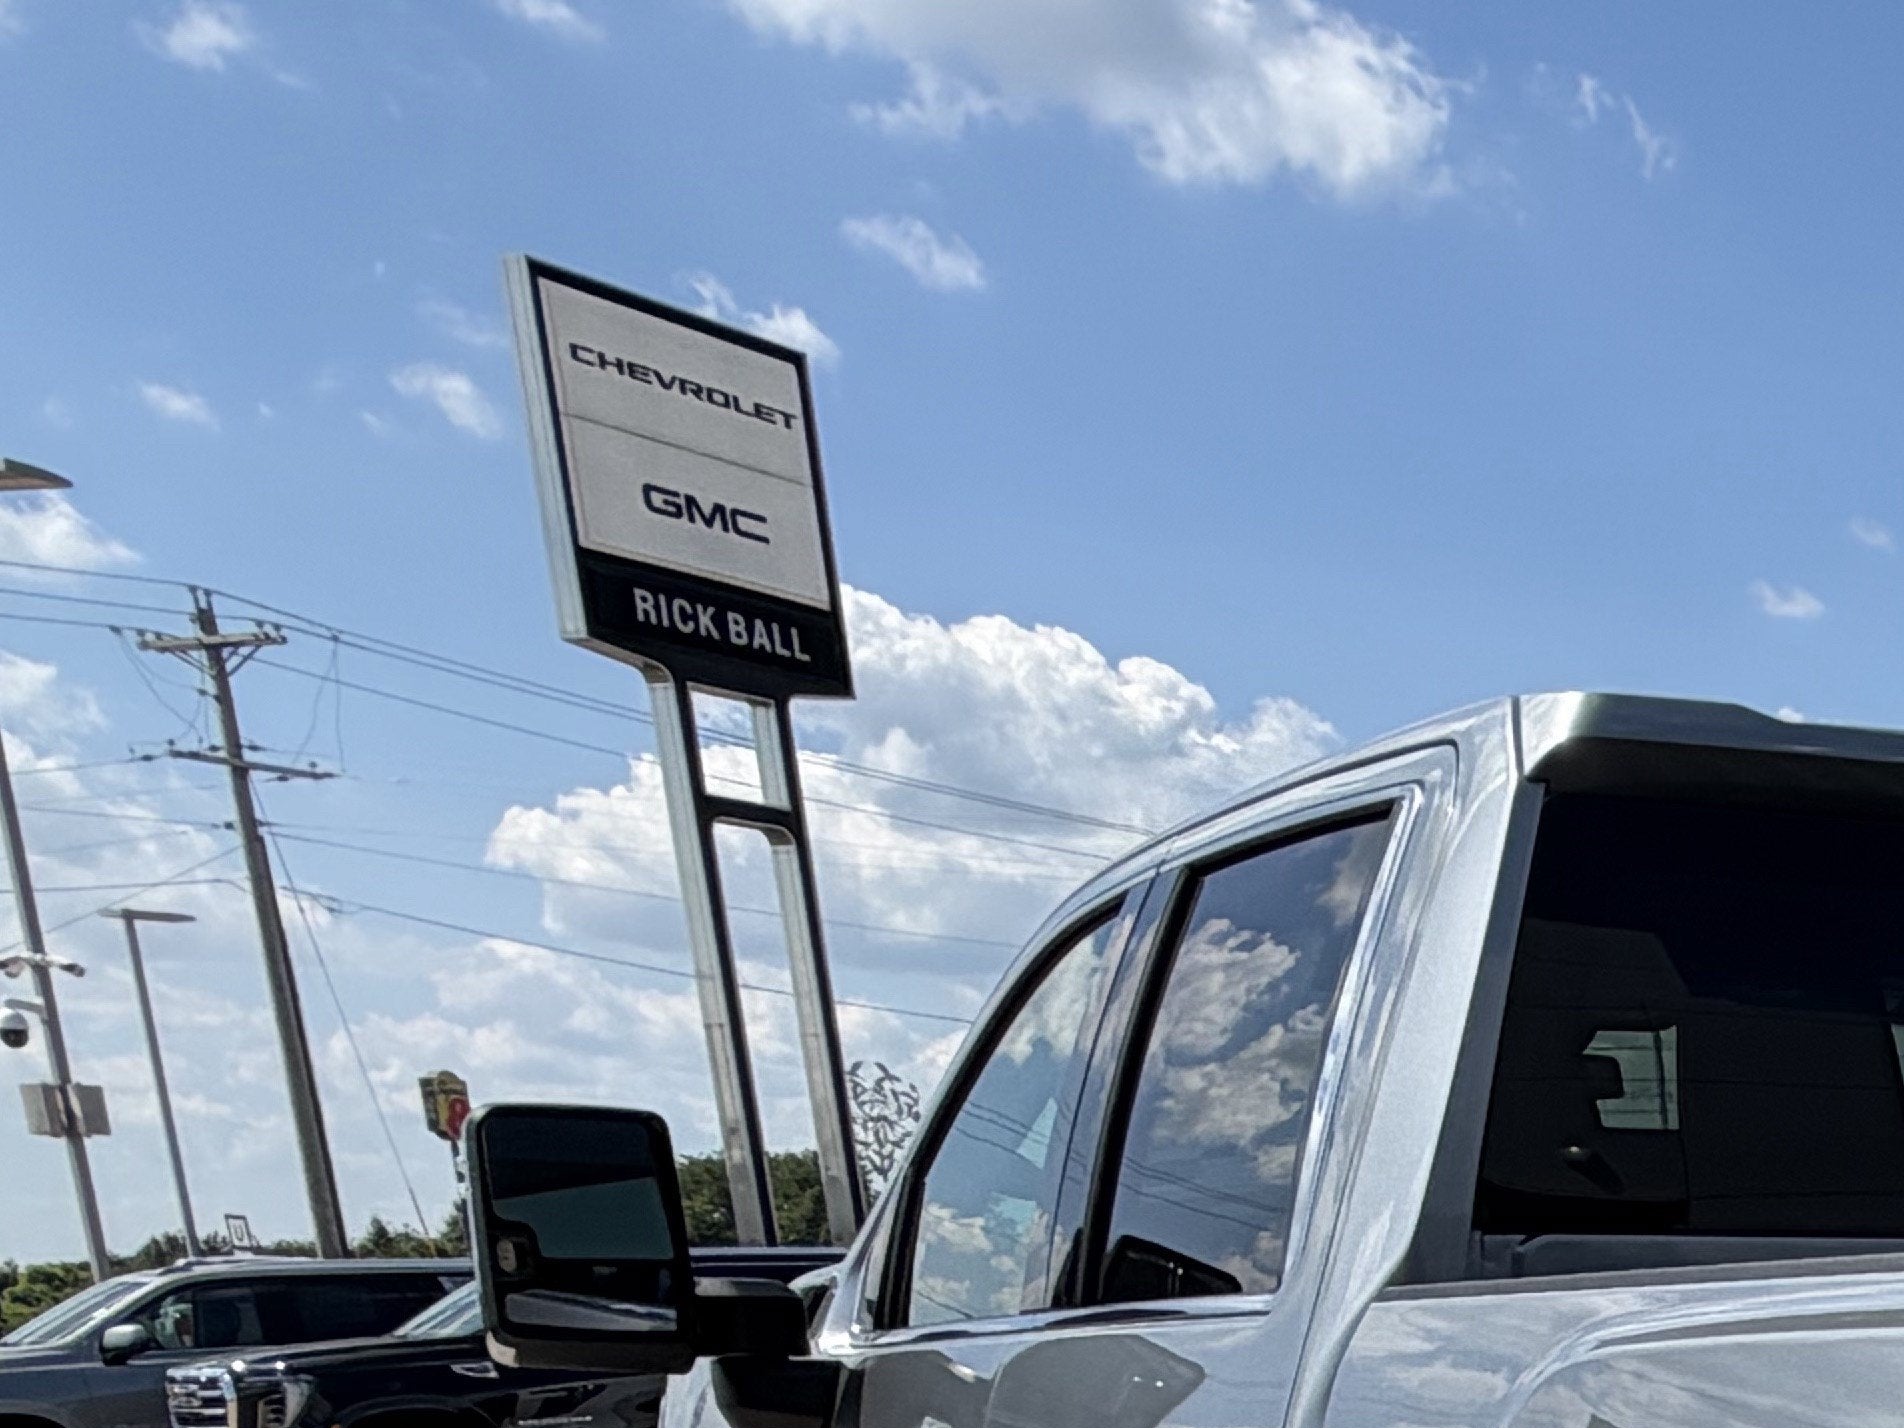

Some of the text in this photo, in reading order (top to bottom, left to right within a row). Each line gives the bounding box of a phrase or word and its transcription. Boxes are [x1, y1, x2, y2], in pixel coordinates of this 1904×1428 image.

[568, 342, 798, 430] CHEVROLET
[641, 483, 771, 545] GMC
[633, 588, 811, 663] RICK BALL
